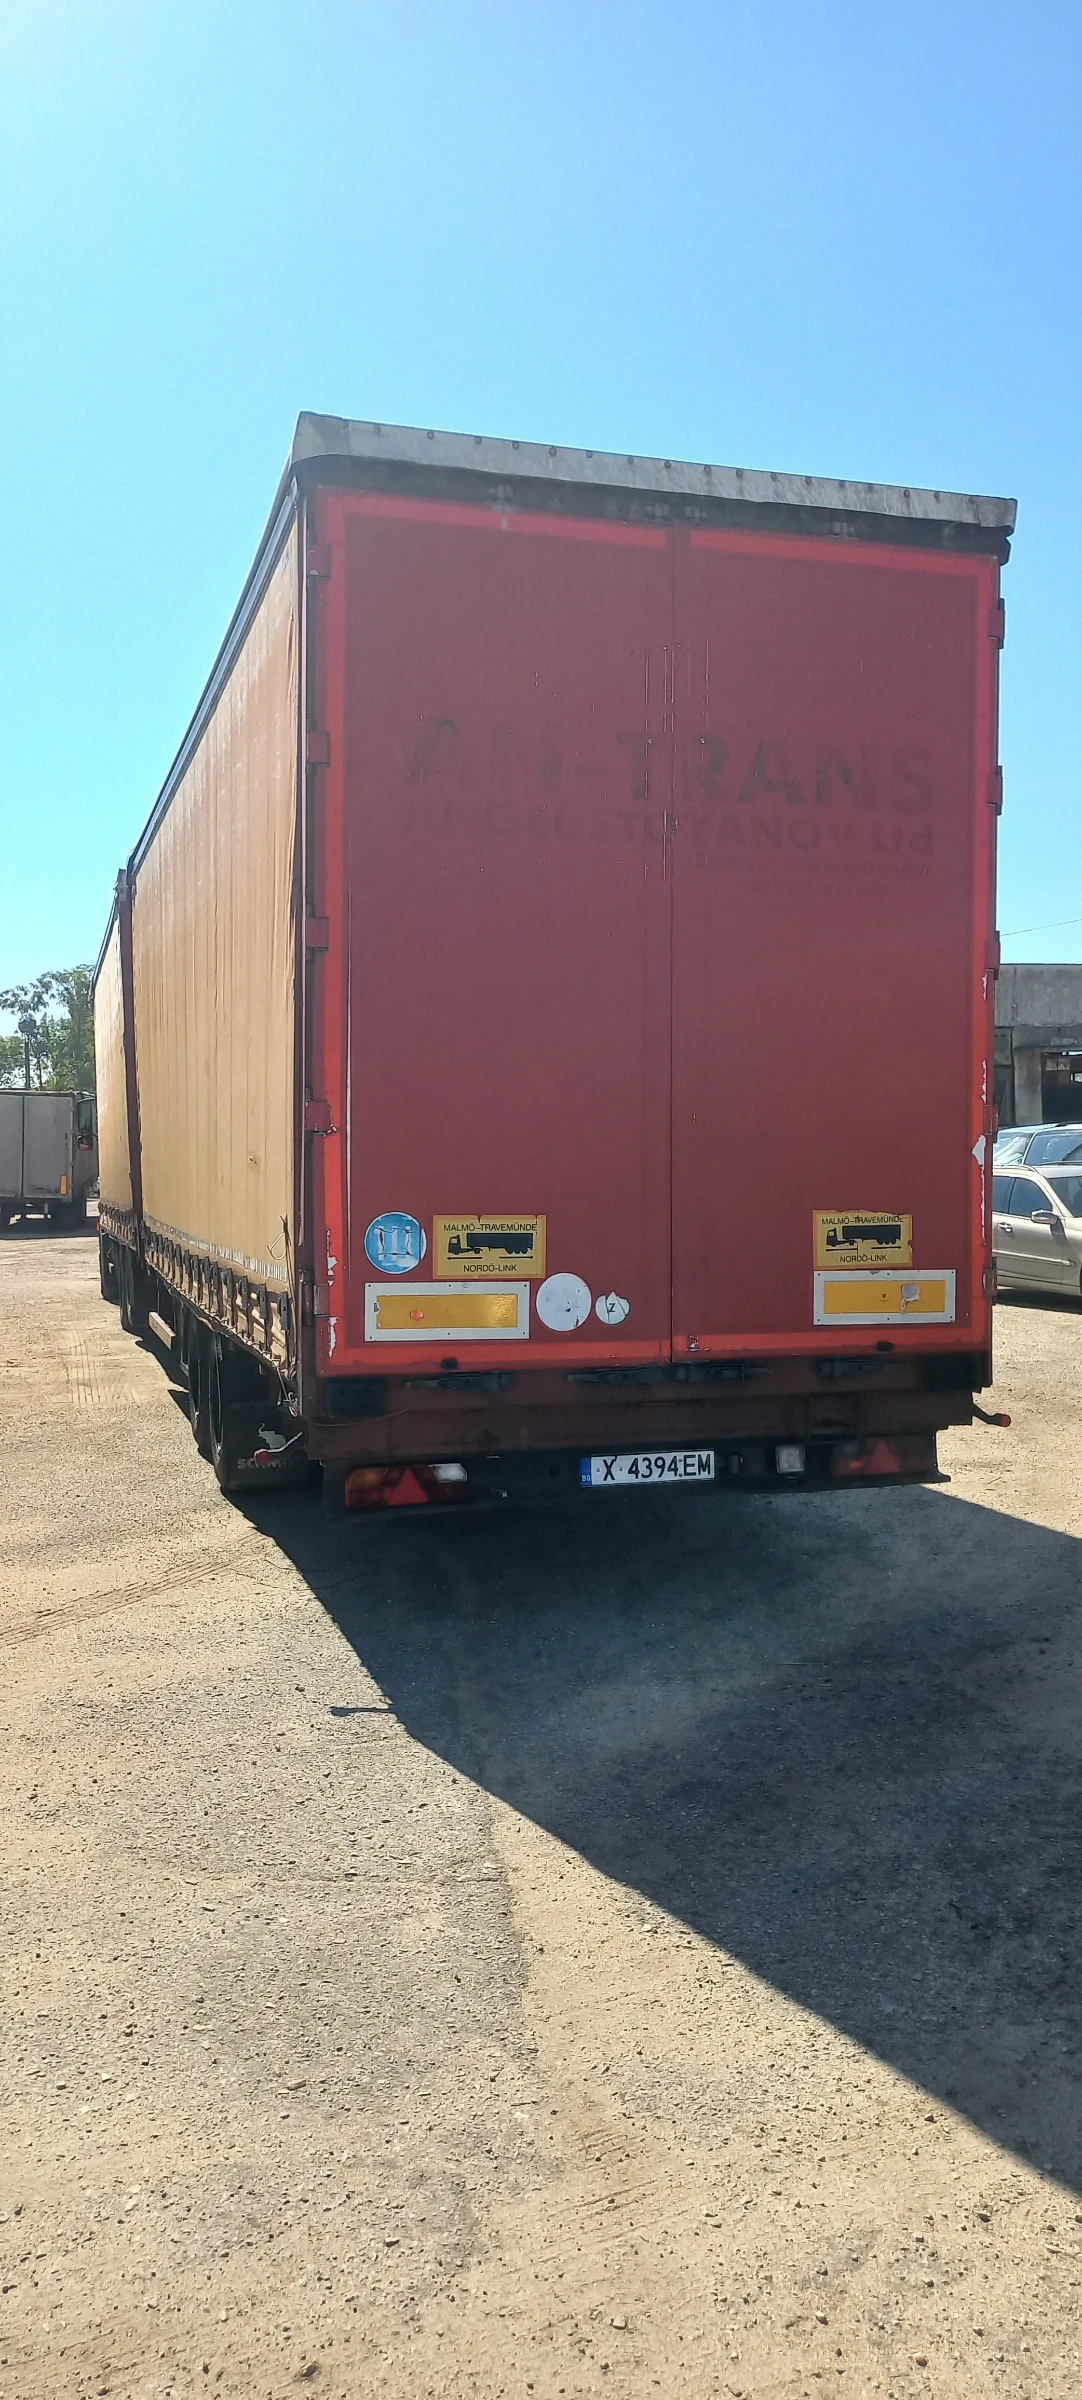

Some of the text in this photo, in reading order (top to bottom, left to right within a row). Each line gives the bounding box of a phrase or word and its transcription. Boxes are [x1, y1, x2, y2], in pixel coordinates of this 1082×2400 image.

[839, 1253, 888, 1263] NORDÖ-LINK
[463, 1262, 517, 1273] NORDÖ-LINK
[602, 1458, 616, 1481] X
[627, 1456, 679, 1479] 4394
[683, 1453, 711, 1476] EM
